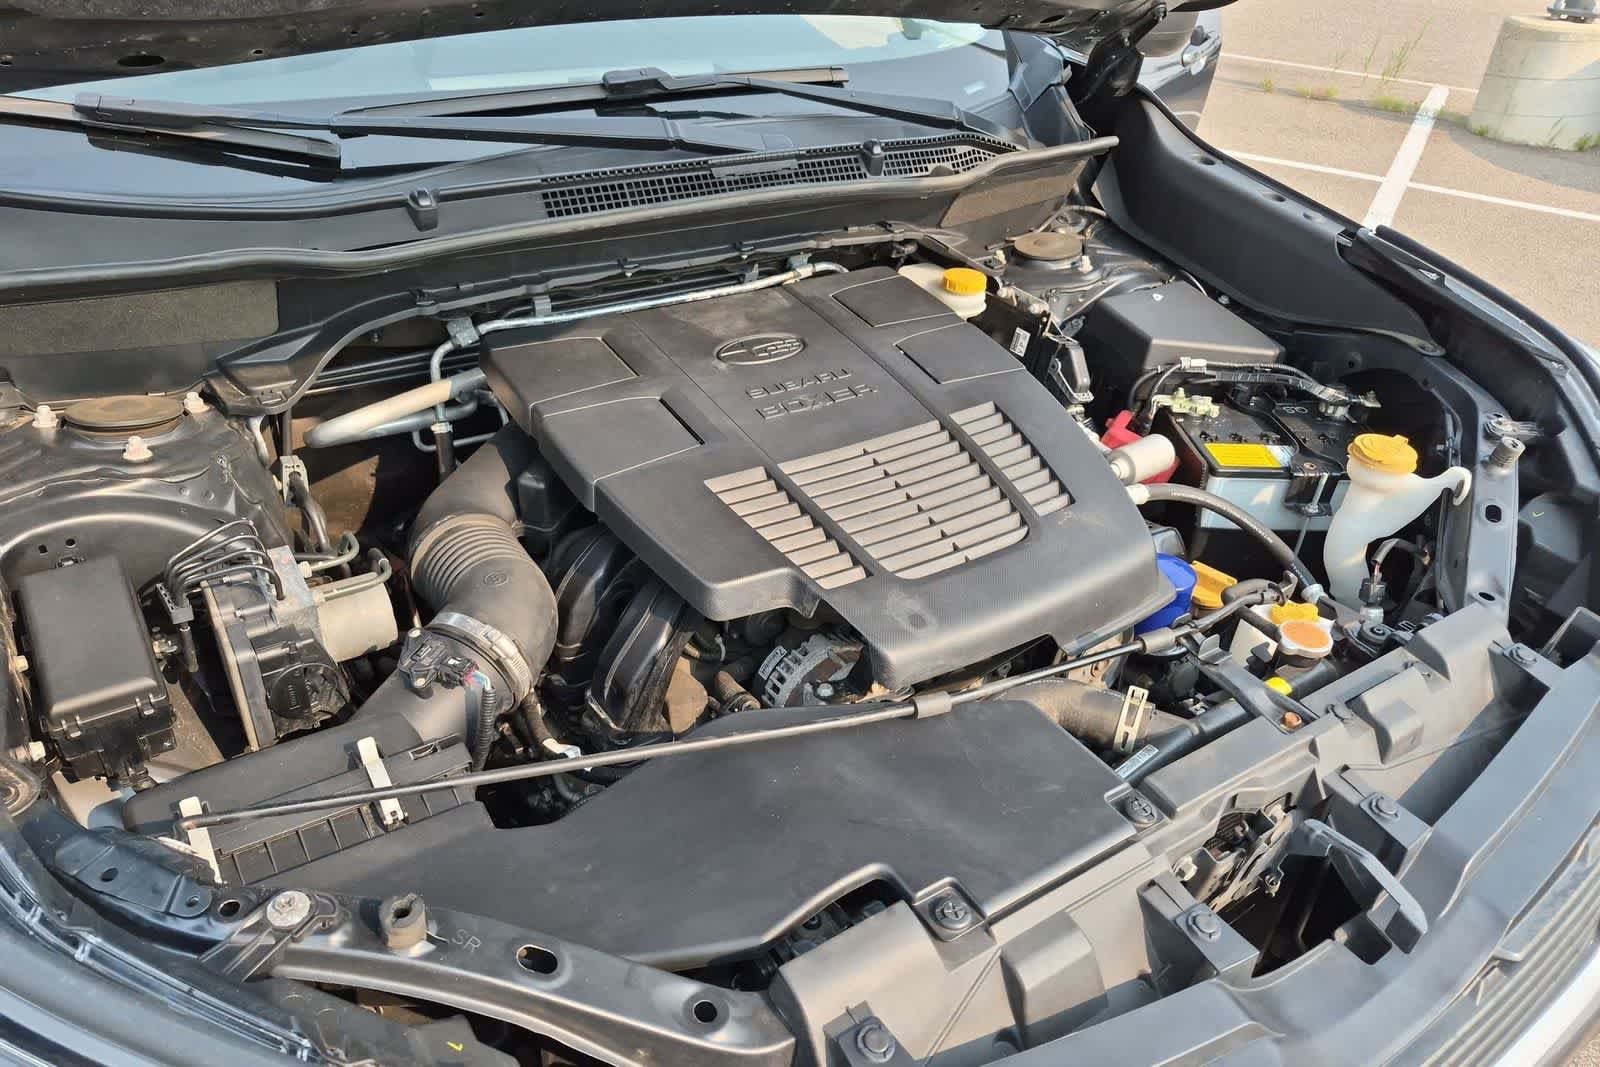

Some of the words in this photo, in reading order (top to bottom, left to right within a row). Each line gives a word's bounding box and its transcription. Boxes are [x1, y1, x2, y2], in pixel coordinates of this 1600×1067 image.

[745, 368, 852, 398] SUBARU
[755, 384, 878, 420] BOXER
[452, 929, 482, 953] SR
